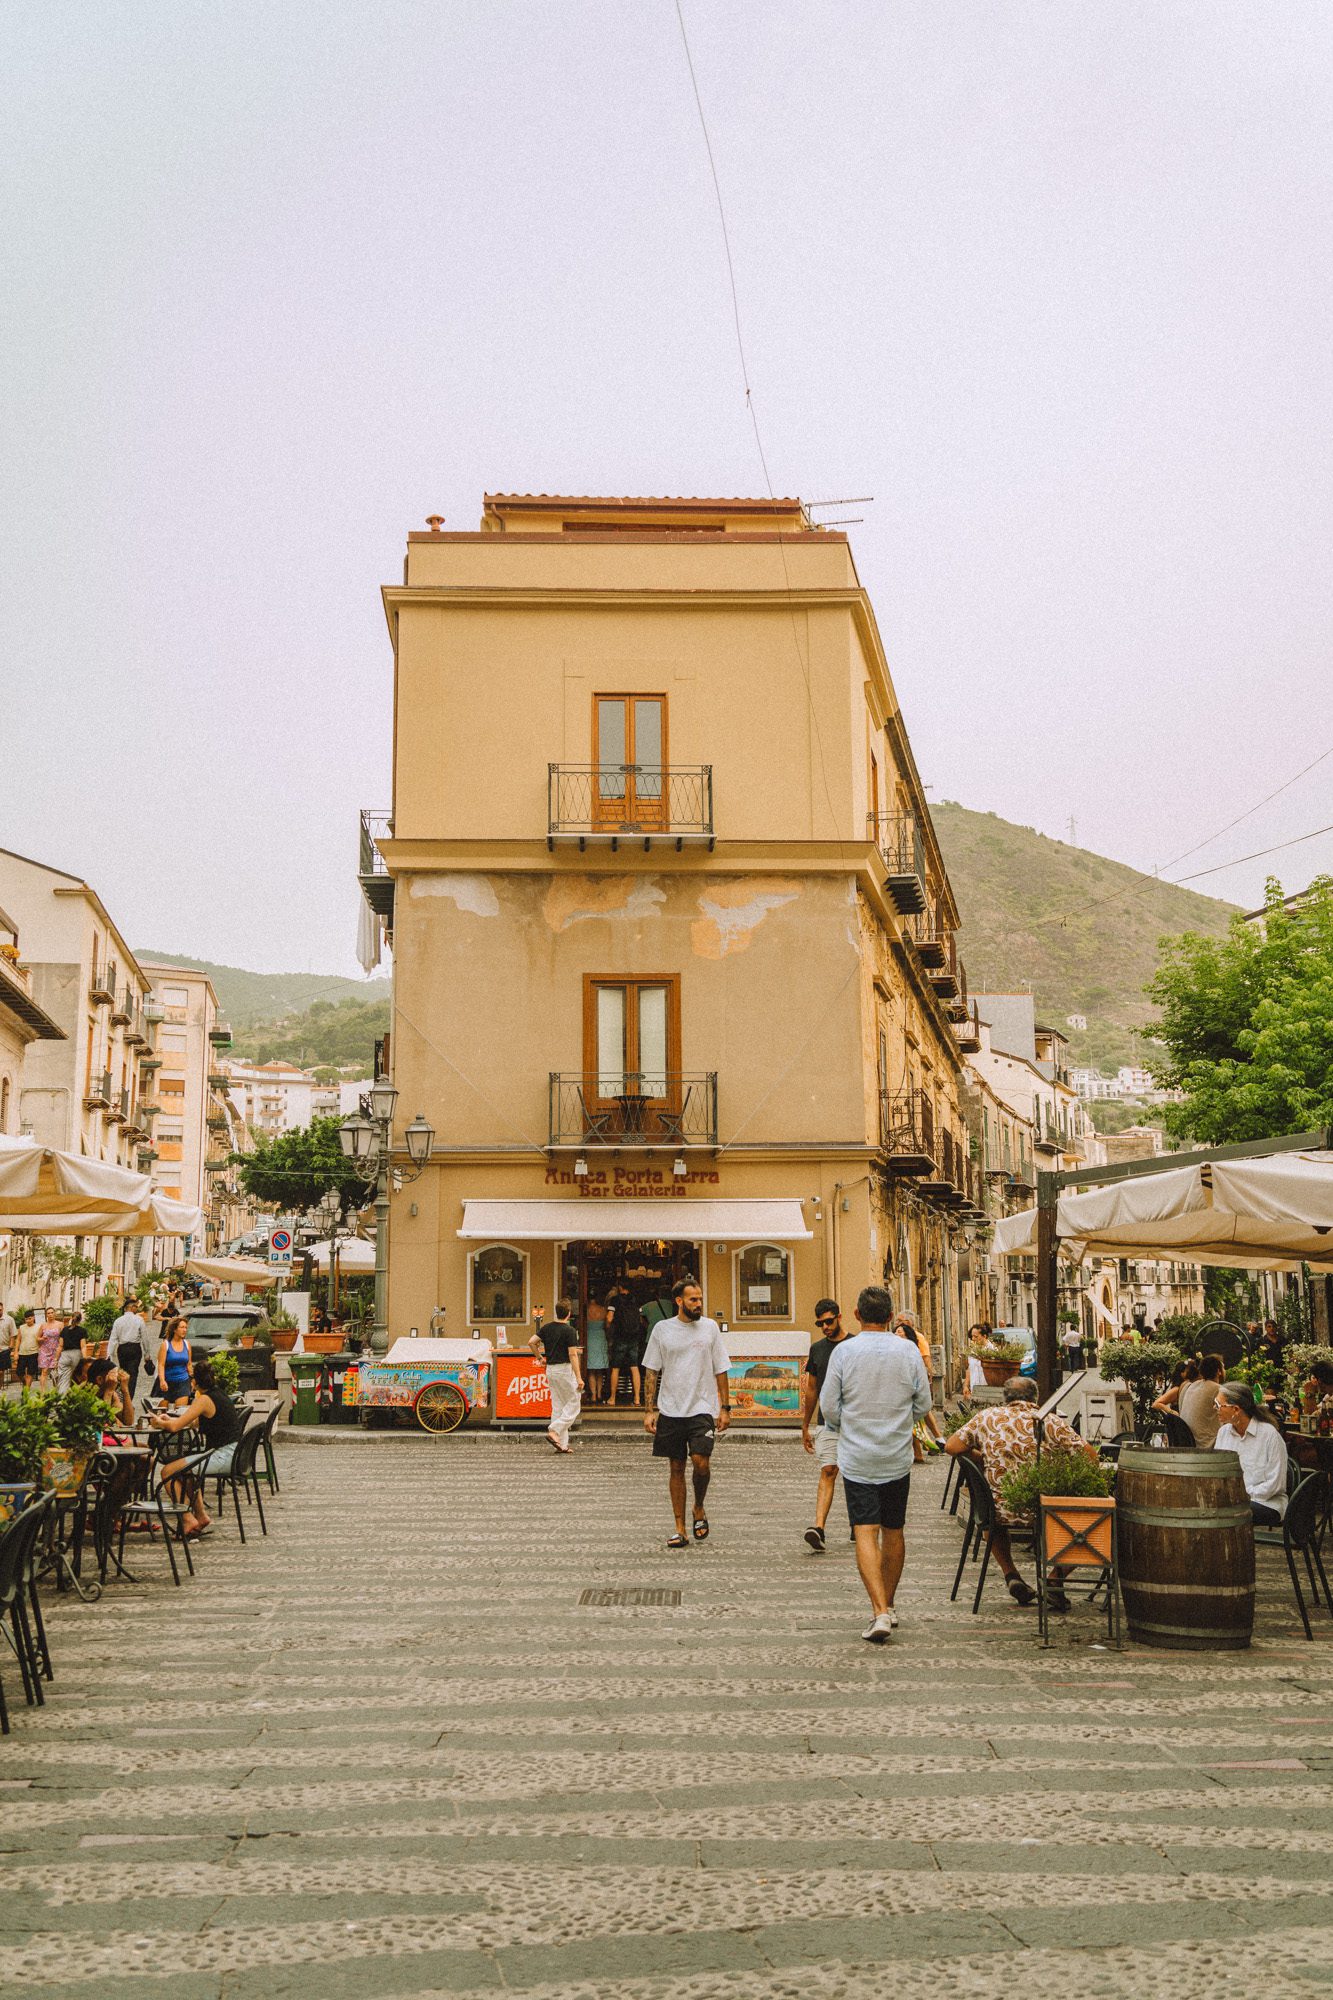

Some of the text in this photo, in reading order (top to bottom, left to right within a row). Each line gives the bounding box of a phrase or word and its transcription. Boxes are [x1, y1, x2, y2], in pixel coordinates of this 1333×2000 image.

[613, 1167, 663, 1184] Porta
[578, 1184, 687, 1197] Bar Gelateria
[717, 1244, 724, 1253] 6
[506, 1373, 551, 1397] APER
[519, 1387, 552, 1405] SPRIT
